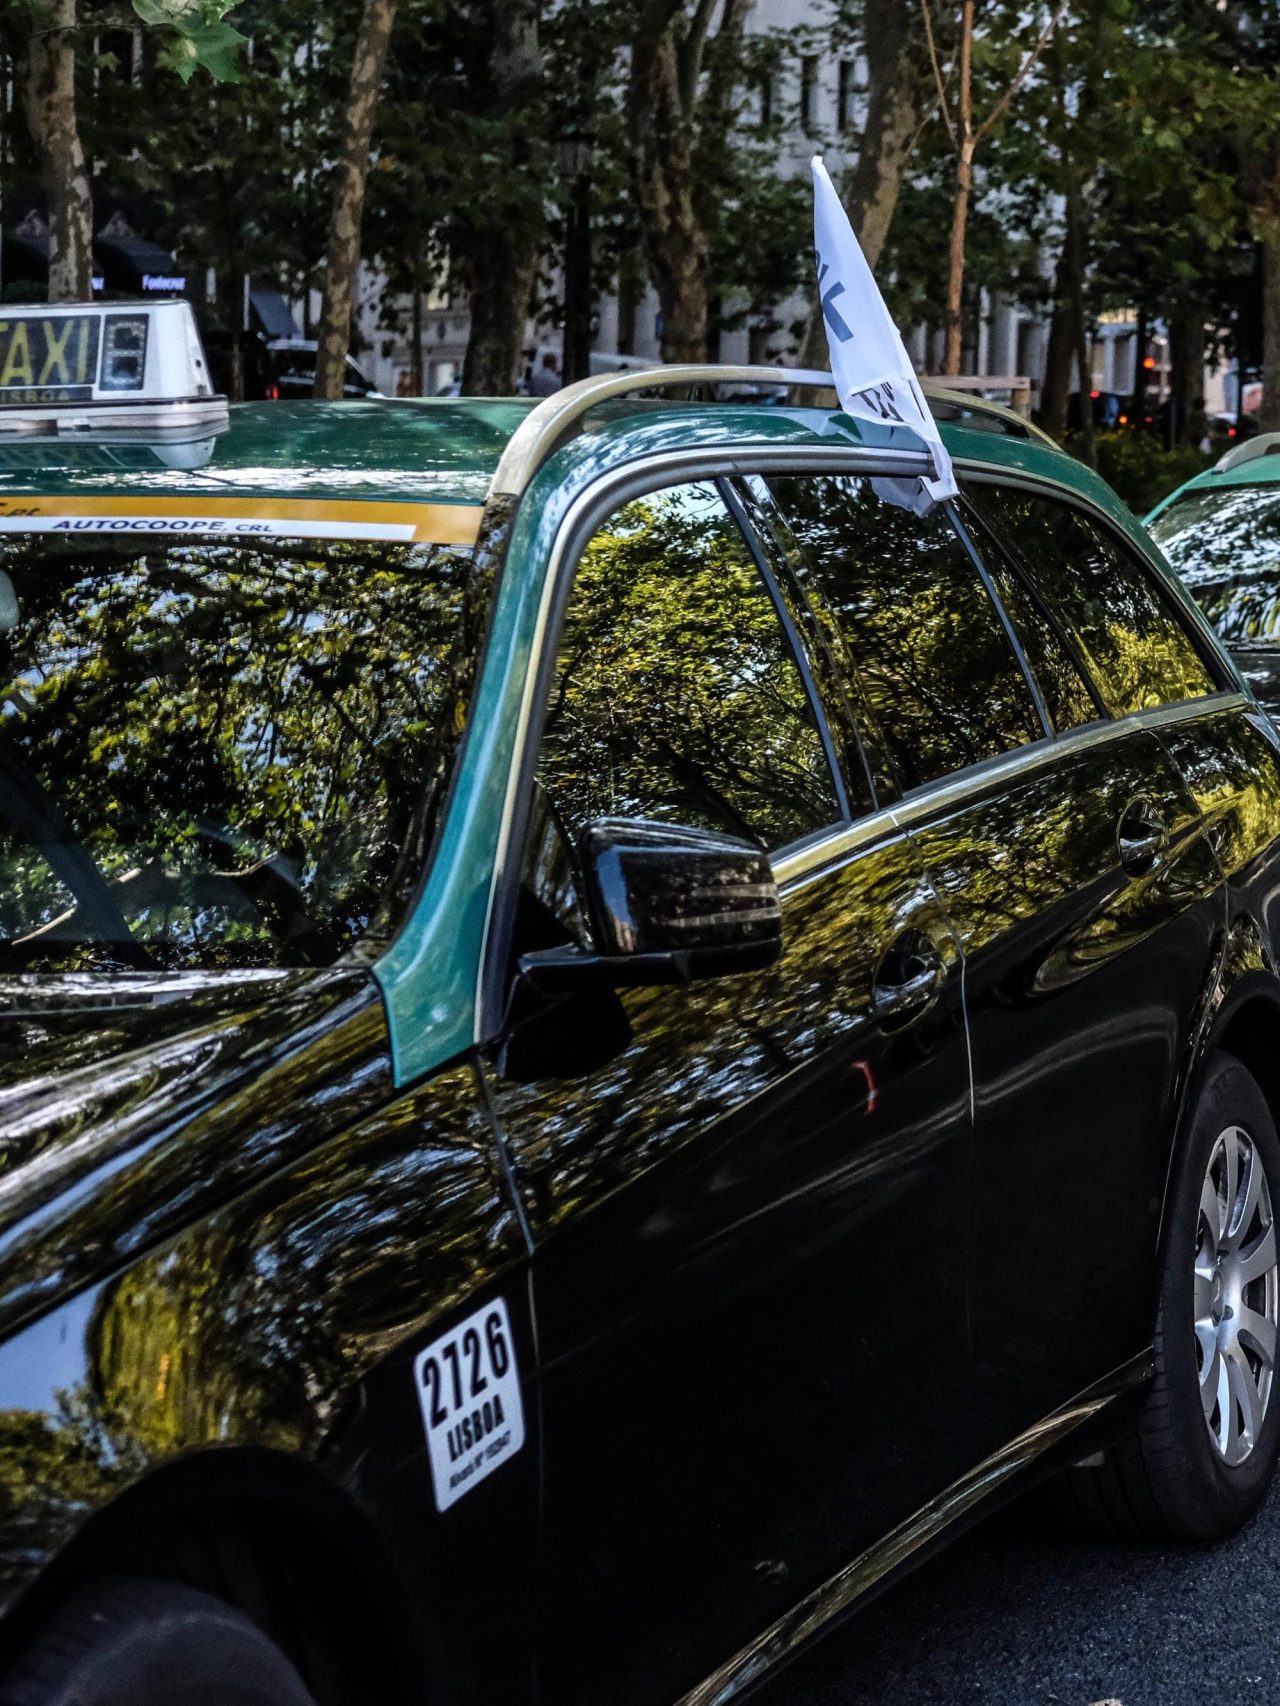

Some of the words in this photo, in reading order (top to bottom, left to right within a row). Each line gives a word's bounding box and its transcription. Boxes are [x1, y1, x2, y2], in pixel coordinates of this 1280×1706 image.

[235, 523, 274, 532] CRL
[422, 1310, 509, 1429] 2726
[447, 1394, 505, 1462] LISBOA
